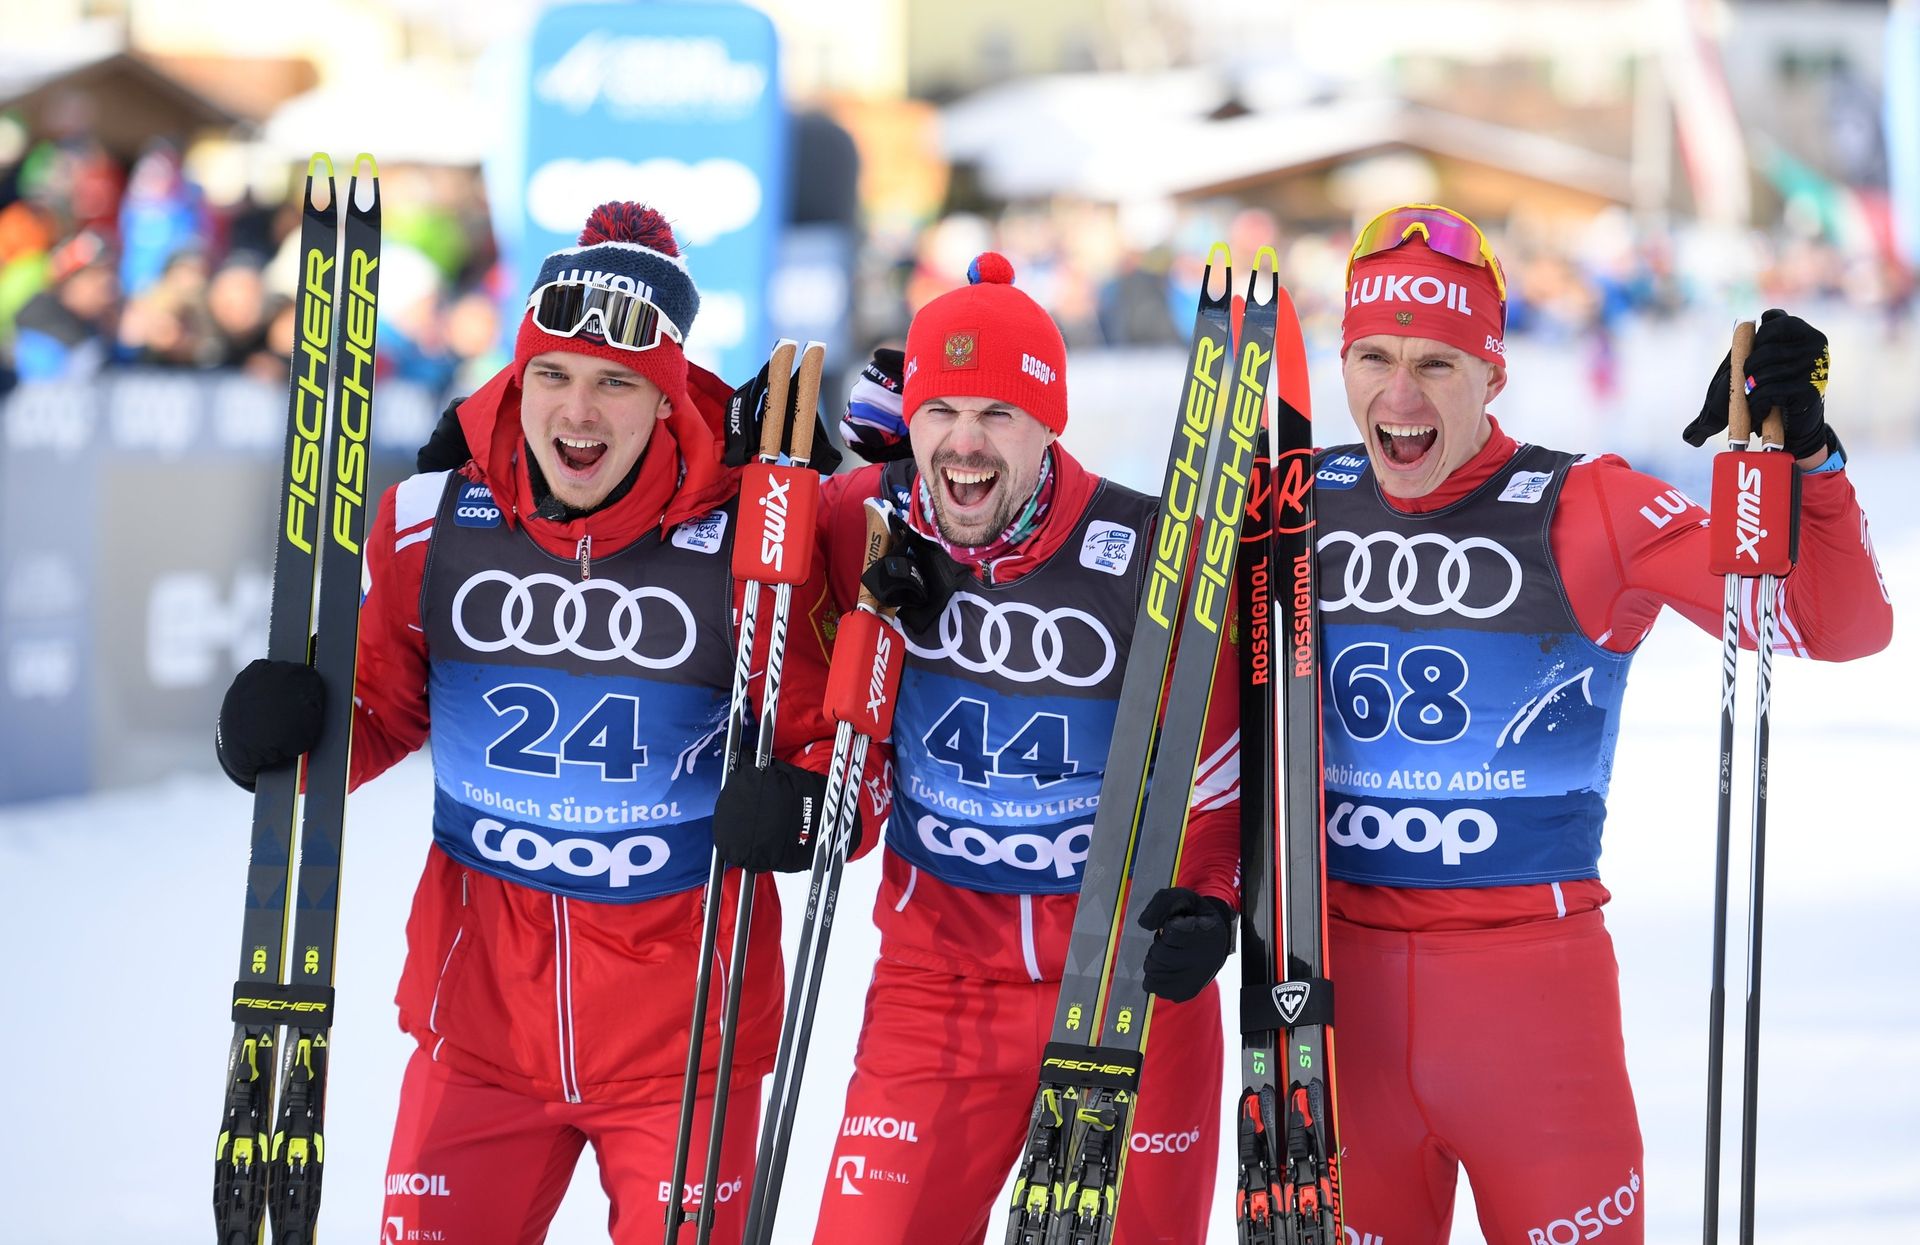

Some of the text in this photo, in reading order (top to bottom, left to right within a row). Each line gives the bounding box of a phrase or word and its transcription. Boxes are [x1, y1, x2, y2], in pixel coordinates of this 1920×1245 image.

[1351, 275, 1472, 316] LUKOIL
[1022, 353, 1050, 384] BOSCO
[286, 248, 335, 555] FISCHER
[333, 249, 379, 555] FISCHER
[1146, 336, 1224, 630] FISCHER
[1194, 341, 1270, 634] FISCHER
[1316, 470, 1358, 484] coop
[457, 507, 500, 521] coop
[1251, 556, 1269, 686] ROSSIGNOL
[1293, 547, 1312, 679] ROSSIGNOL
[1330, 642, 1471, 745] 68
[482, 683, 648, 783] 24
[922, 696, 1079, 790] 44
[1324, 763, 1382, 789] obbiaco
[462, 781, 541, 818] Toblach
[917, 815, 1095, 879] coop
[1327, 802, 1498, 866] coop
[471, 818, 671, 888] coop
[252, 950, 267, 974] 3D
[304, 950, 319, 975] 3D
[234, 998, 327, 1012] FISCHER
[1066, 1006, 1082, 1031] 3D
[1116, 1010, 1132, 1034] 3D
[1043, 1058, 1136, 1077] FISCHER
[1253, 1052, 1265, 1075] S1
[1300, 1045, 1312, 1069] S1
[842, 1116, 918, 1143] LUKOIL
[1130, 1132, 1191, 1154] OSCO
[386, 1173, 450, 1196] LUKOIL
[869, 1169, 910, 1185] RUSAL
[1527, 1185, 1636, 1245] BOSCO
[407, 1229, 446, 1241] RUSAL
